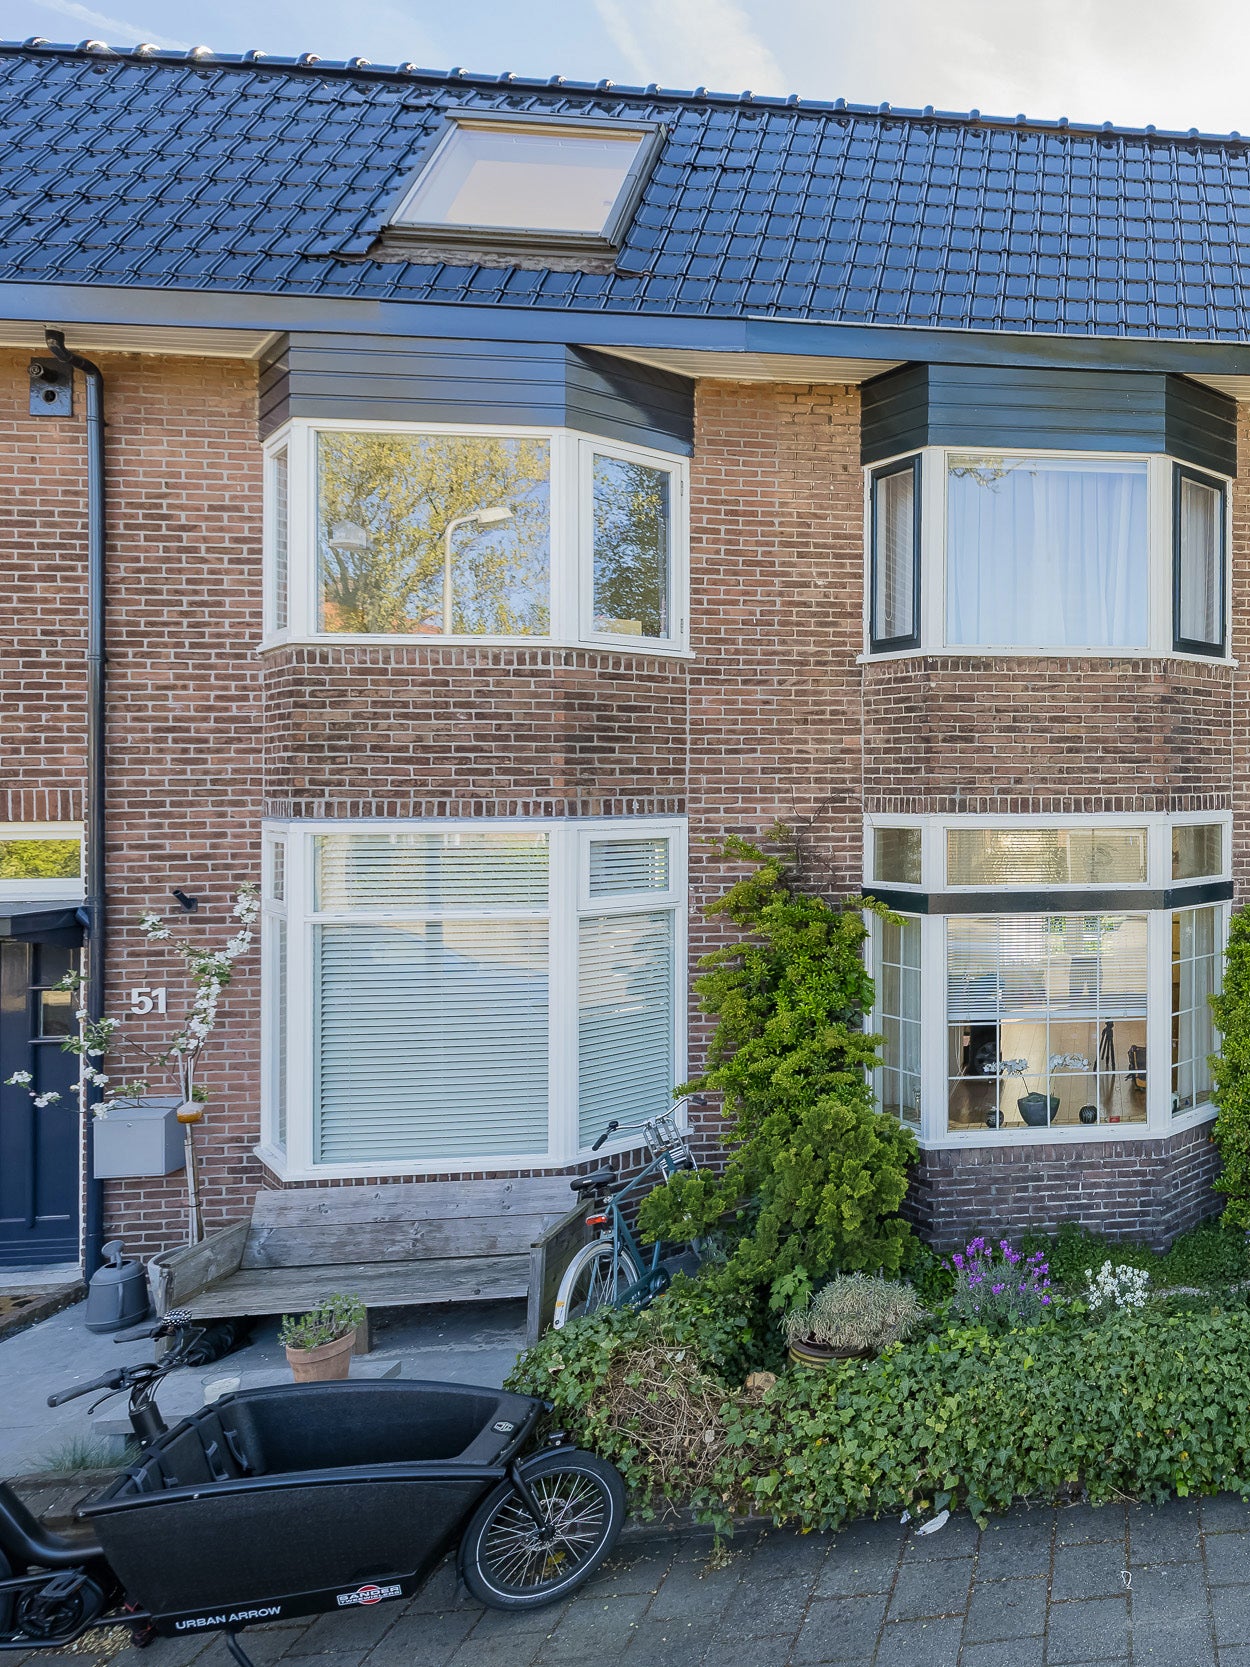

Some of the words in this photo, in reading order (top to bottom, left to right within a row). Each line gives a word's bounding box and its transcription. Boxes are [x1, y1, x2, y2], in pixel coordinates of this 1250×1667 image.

[131, 987, 167, 1015] 51
[340, 1587, 399, 1600] SANDER
[175, 1615, 226, 1629] URBAN
[228, 1606, 281, 1622] ARROW
